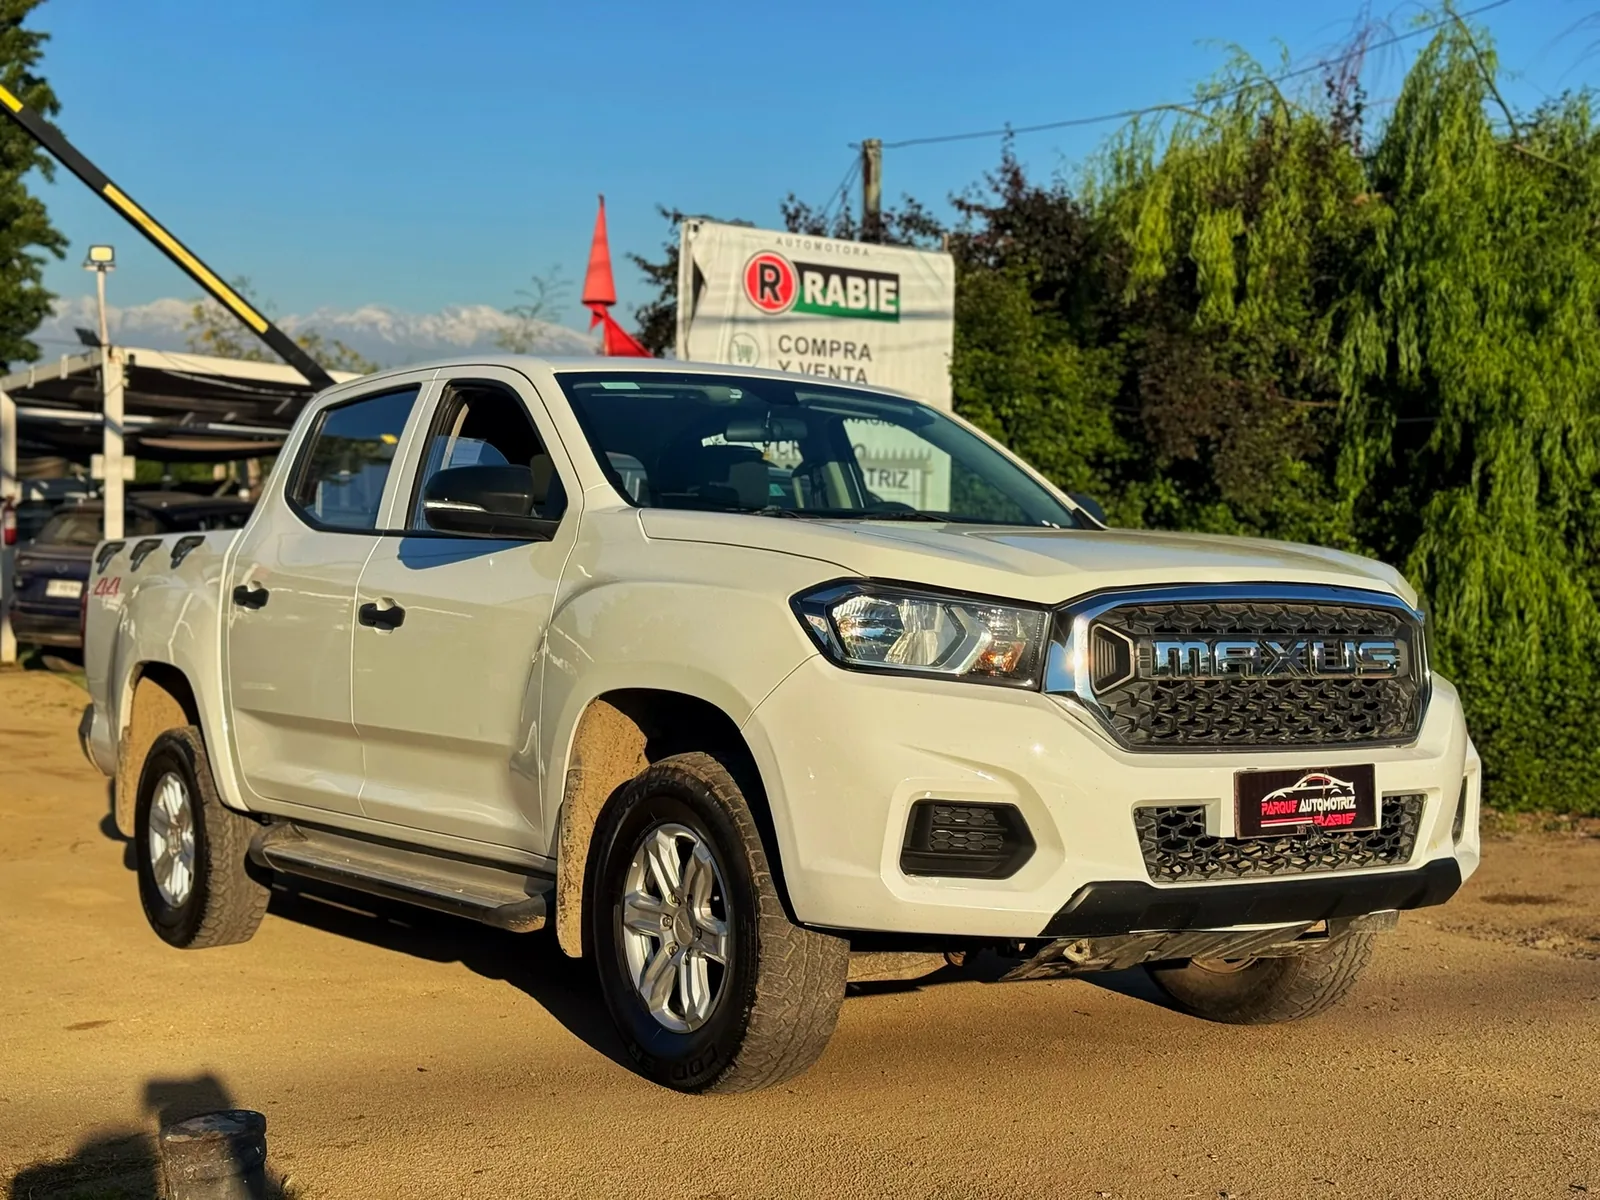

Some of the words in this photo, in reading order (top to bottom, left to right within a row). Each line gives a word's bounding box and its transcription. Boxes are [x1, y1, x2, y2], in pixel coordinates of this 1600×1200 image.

[776, 236, 870, 257] AUTOMOTORA
[758, 263, 783, 304] R
[802, 271, 898, 313] RABIE
[778, 334, 872, 362] COMPRA
[799, 361, 869, 386] VENTA
[1153, 640, 1398, 678] MAXUS
[1261, 800, 1298, 816] PARQUE
[1299, 796, 1356, 812] AUTOMOTRIZ
[1313, 813, 1356, 827] RABIE
